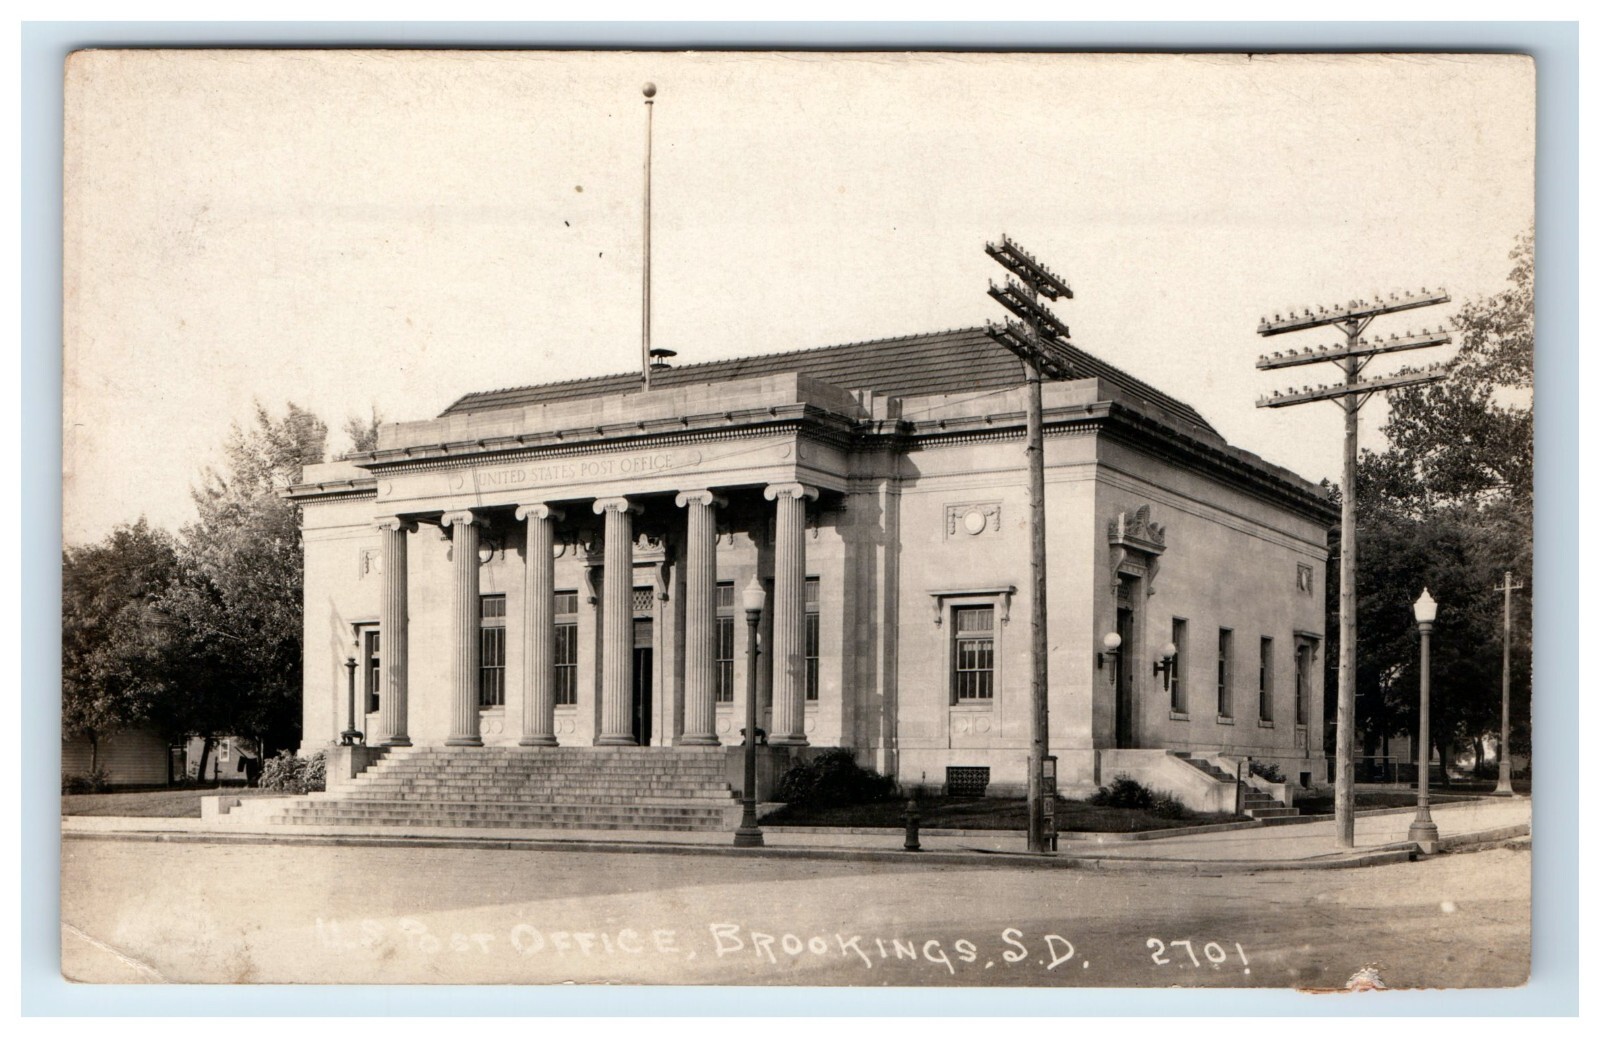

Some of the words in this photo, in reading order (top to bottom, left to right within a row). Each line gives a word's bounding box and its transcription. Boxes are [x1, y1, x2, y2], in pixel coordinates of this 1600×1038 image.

[478, 469, 526, 486] UNITED
[531, 462, 576, 482] STATES
[580, 460, 615, 477] POST
[620, 454, 673, 473] OFFICE
